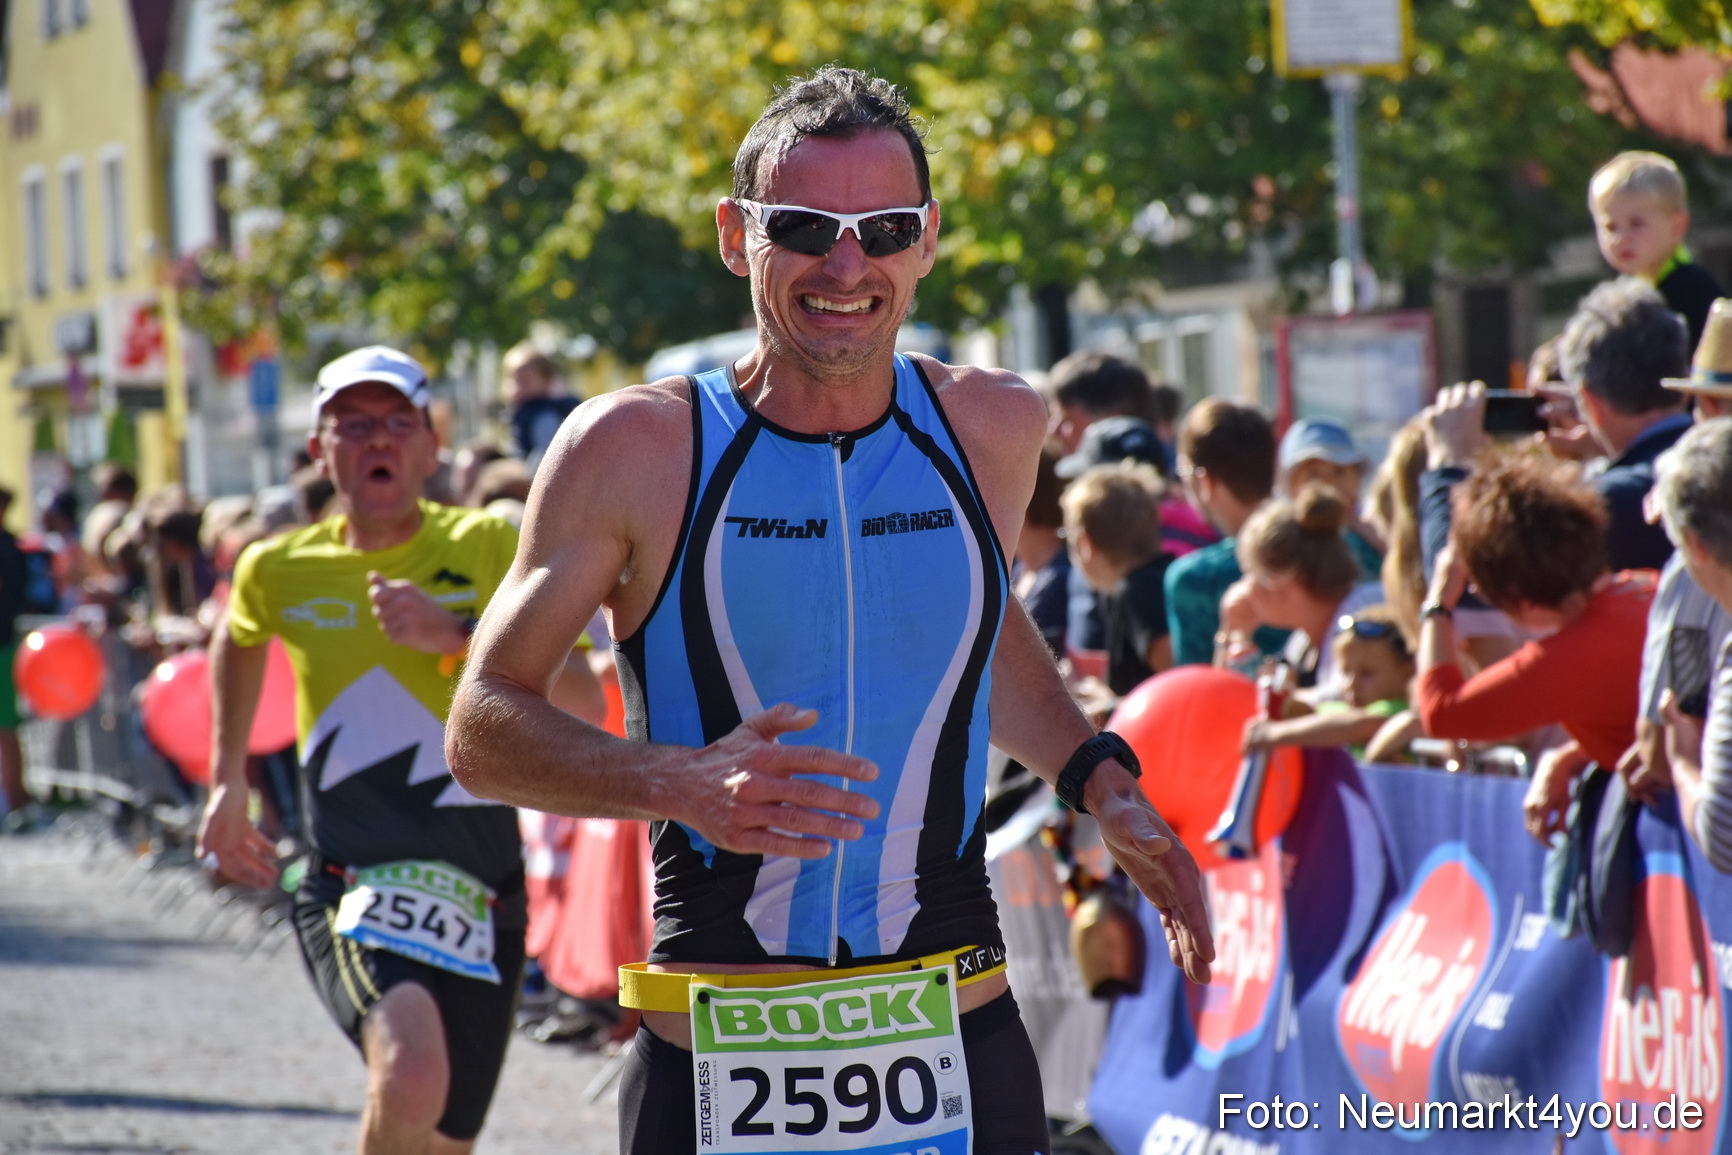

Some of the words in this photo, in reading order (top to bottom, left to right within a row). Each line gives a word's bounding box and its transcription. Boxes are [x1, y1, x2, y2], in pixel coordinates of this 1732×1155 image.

[363, 892, 473, 949] 2547
[714, 983, 933, 1042] BOCK
[939, 1056, 952, 1070] B
[729, 1055, 938, 1137] 2590
